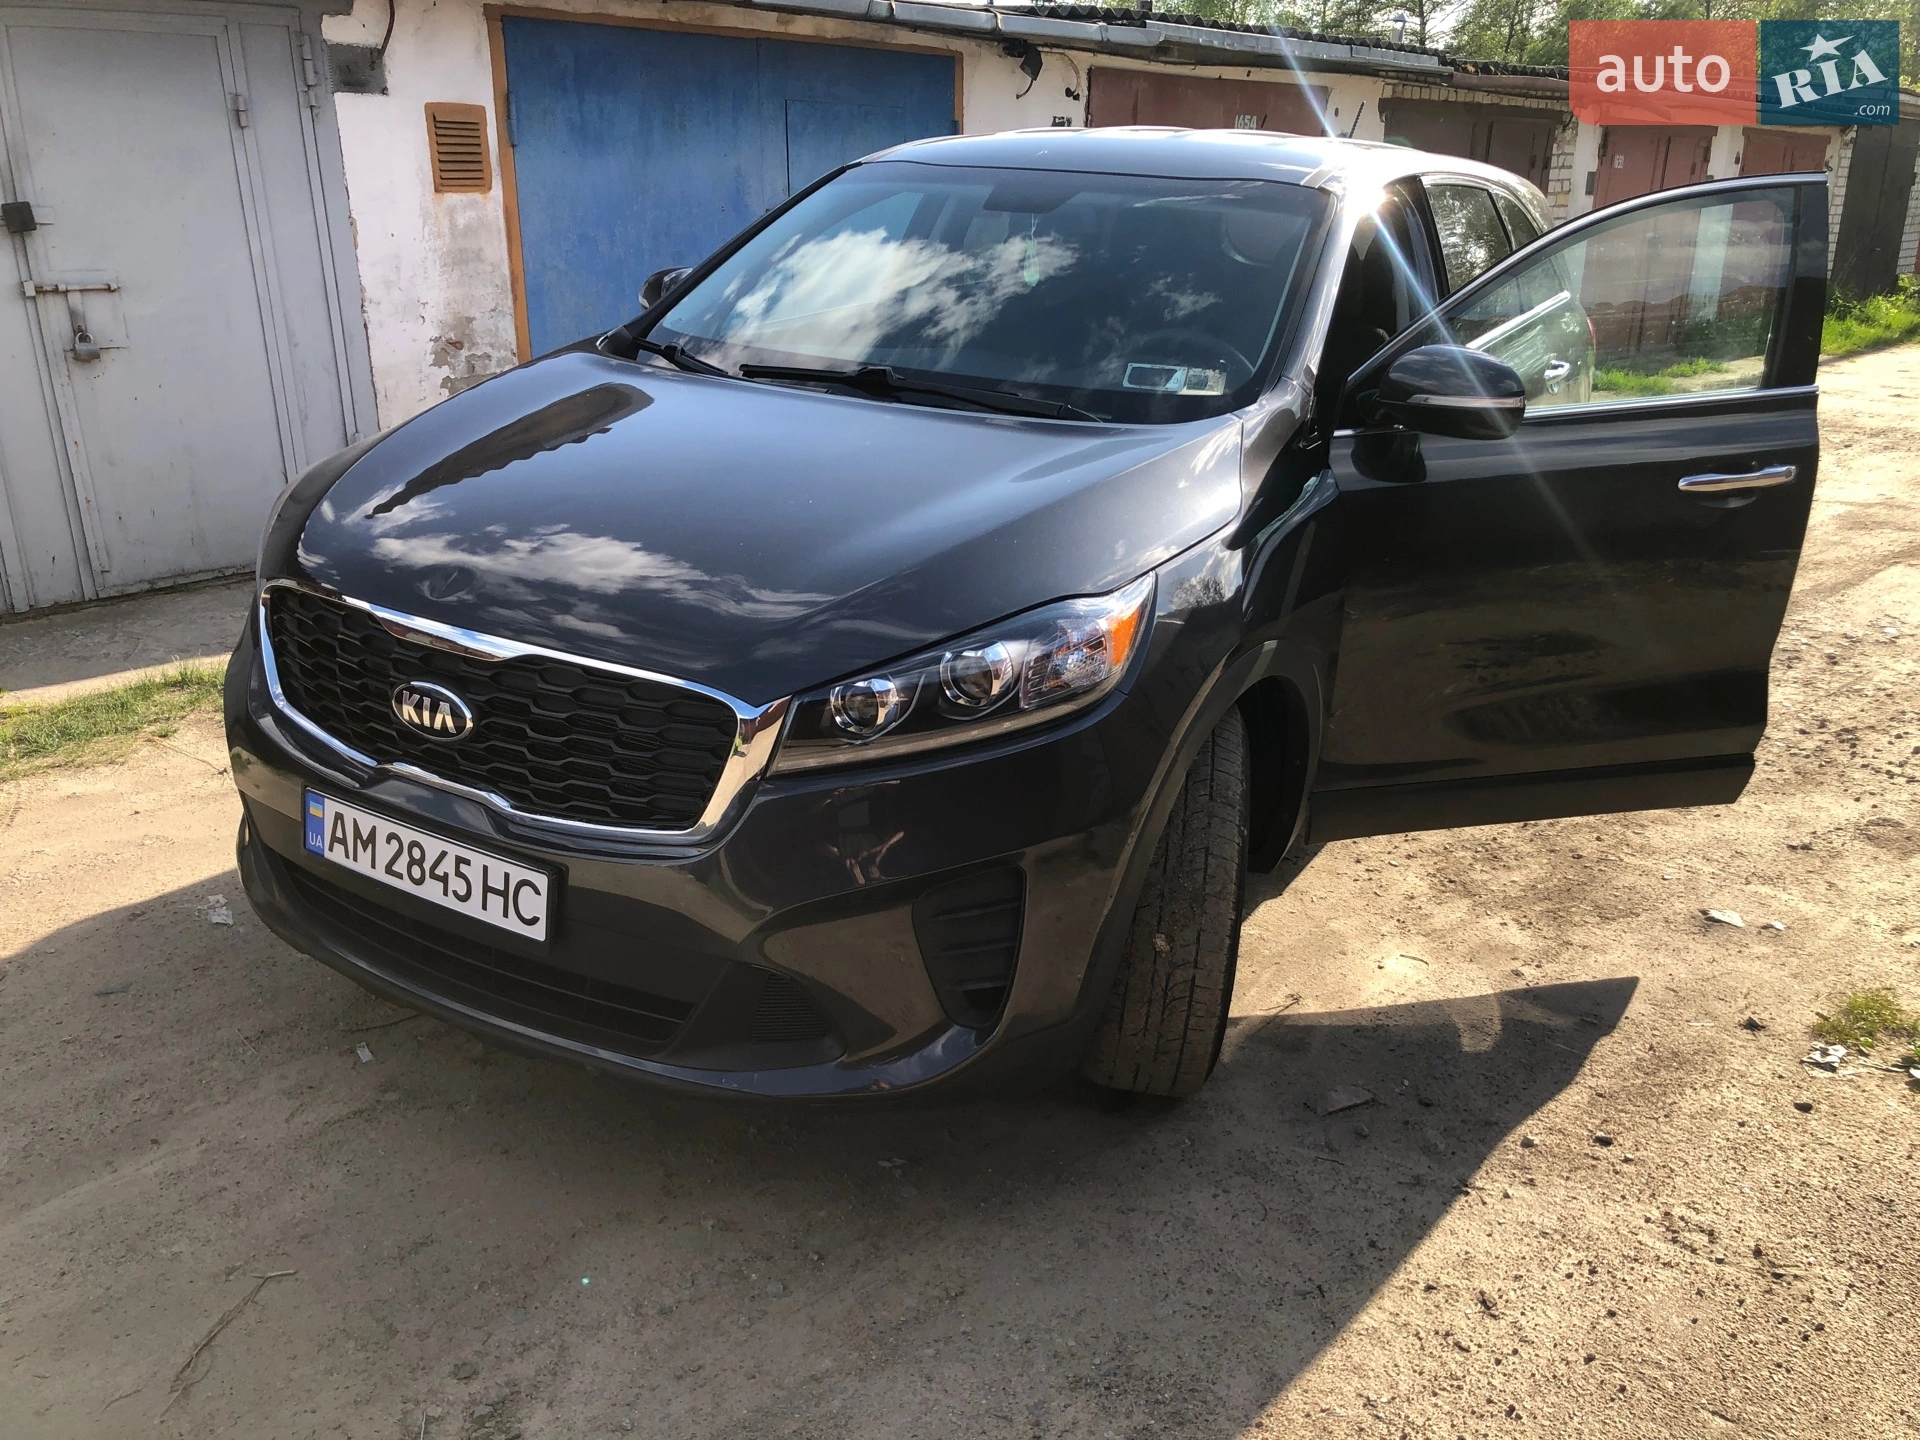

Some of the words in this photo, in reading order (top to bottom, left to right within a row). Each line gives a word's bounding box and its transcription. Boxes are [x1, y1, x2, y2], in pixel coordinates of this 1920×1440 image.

[1234, 114, 1257, 130] 1654
[402, 690, 457, 734] KIA
[309, 830, 323, 849] UA
